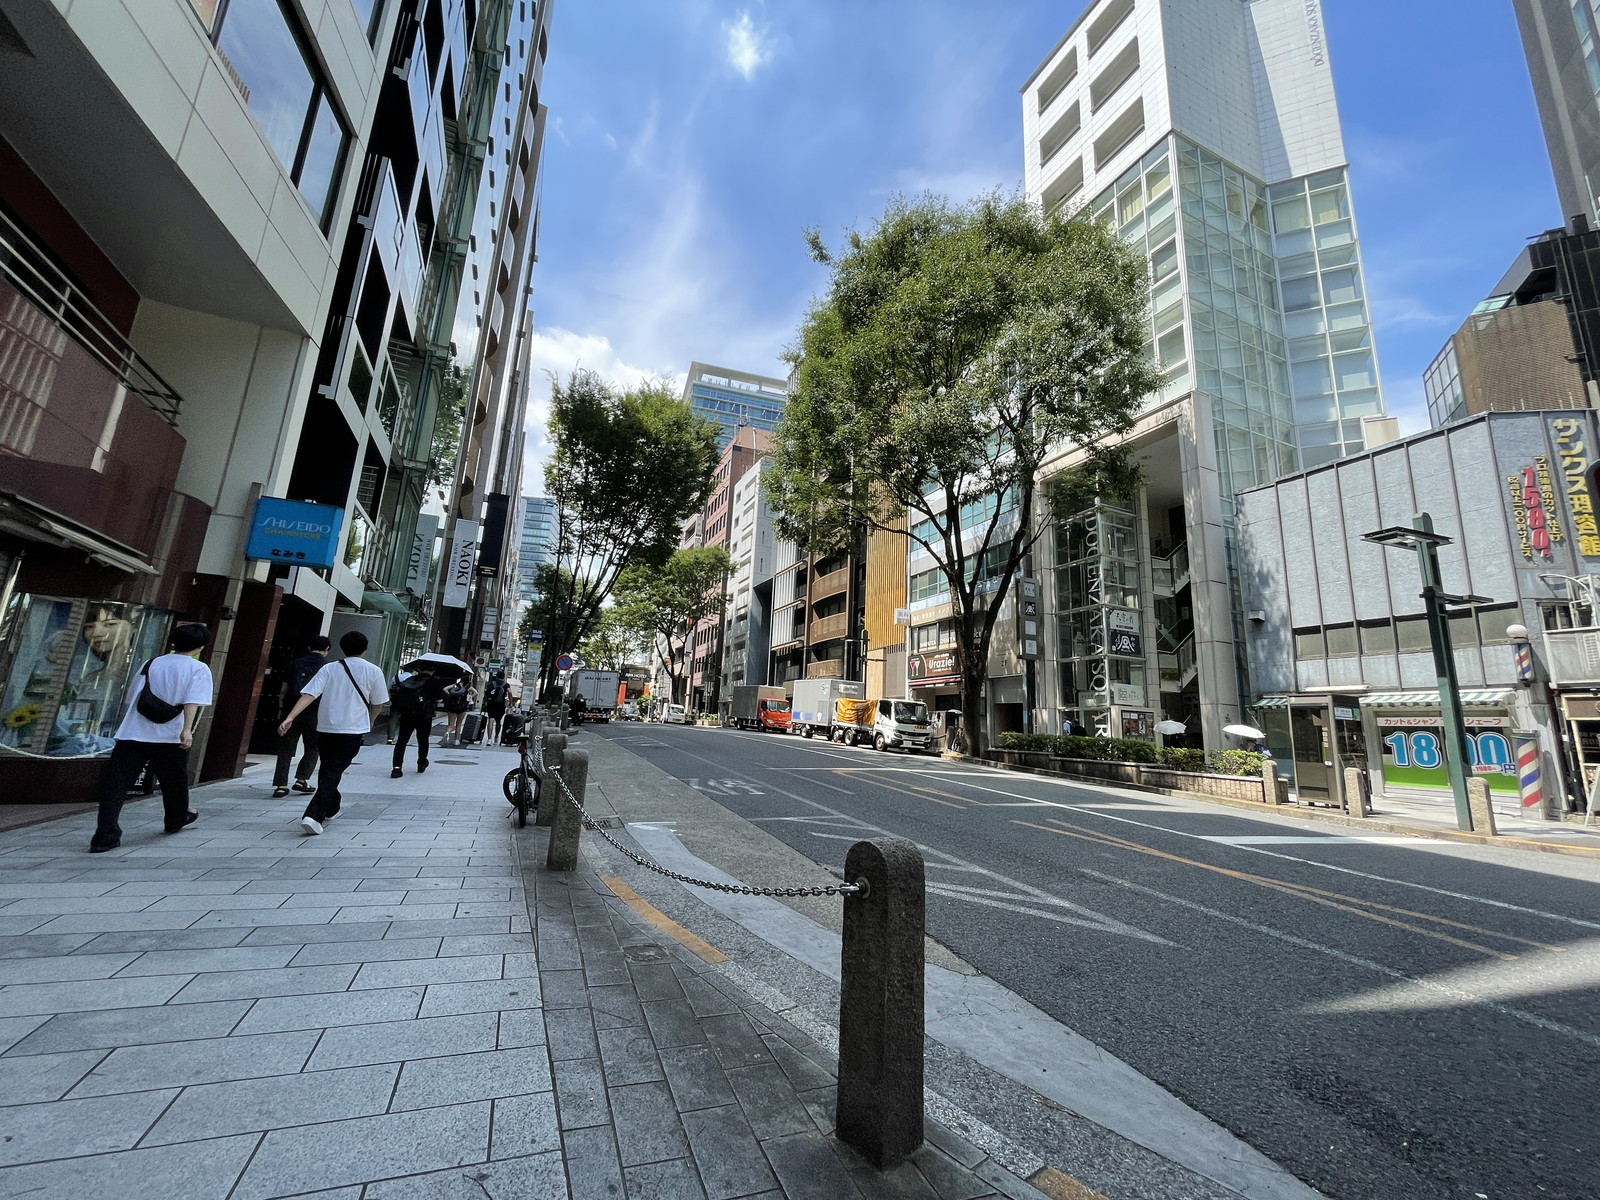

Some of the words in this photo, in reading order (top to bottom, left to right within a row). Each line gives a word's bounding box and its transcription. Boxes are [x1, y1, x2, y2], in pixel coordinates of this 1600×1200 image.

[257, 516, 331, 534] SHISEIDO
[456, 540, 474, 587] NAOKI
[1084, 515, 1106, 657] DOGENZAKA
[1091, 657, 1111, 738] SQUAR
